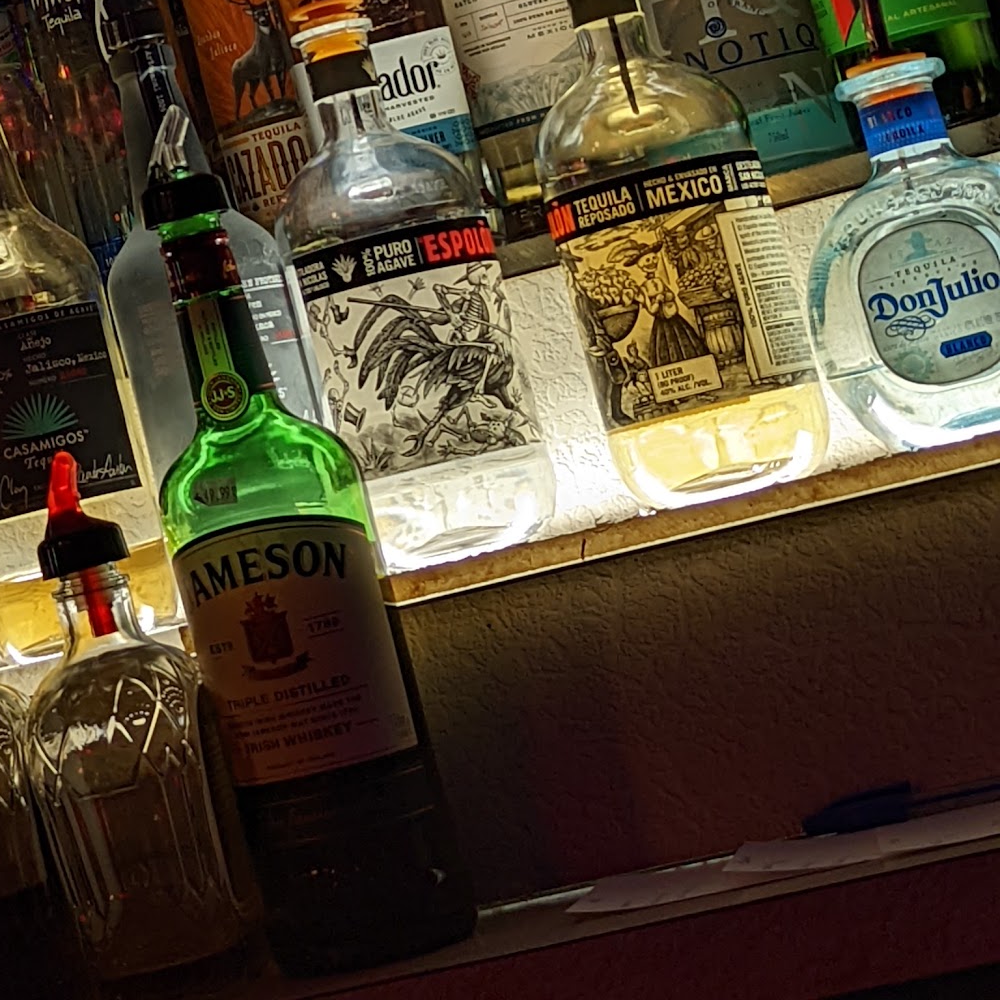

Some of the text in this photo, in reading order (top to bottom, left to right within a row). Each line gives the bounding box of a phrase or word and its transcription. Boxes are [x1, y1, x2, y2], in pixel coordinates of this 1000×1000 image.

[41, 5, 83, 36] Tequila
[683, 22, 816, 72] NOTIQ
[378, 55, 439, 101] ador
[251, 121, 302, 142] TEQUILA
[224, 135, 312, 206] CAZADO
[573, 186, 632, 216] TEQUILA
[645, 174, 723, 210] MEXICO
[576, 203, 636, 229] REPOSADO
[361, 246, 376, 277] 100%
[373, 239, 412, 261] PURO
[376, 253, 416, 274] AGAVE
[894, 256, 956, 278] TEQUILA
[660, 366, 684, 380] LITER
[3, 430, 84, 461] CASAMIGOS
[23, 454, 53, 471] Tequ
[190, 540, 347, 608] AMESON
[227, 673, 352, 712] TRIPLE DISTILLED
[244, 720, 353, 755] IRISH WHISKEY
